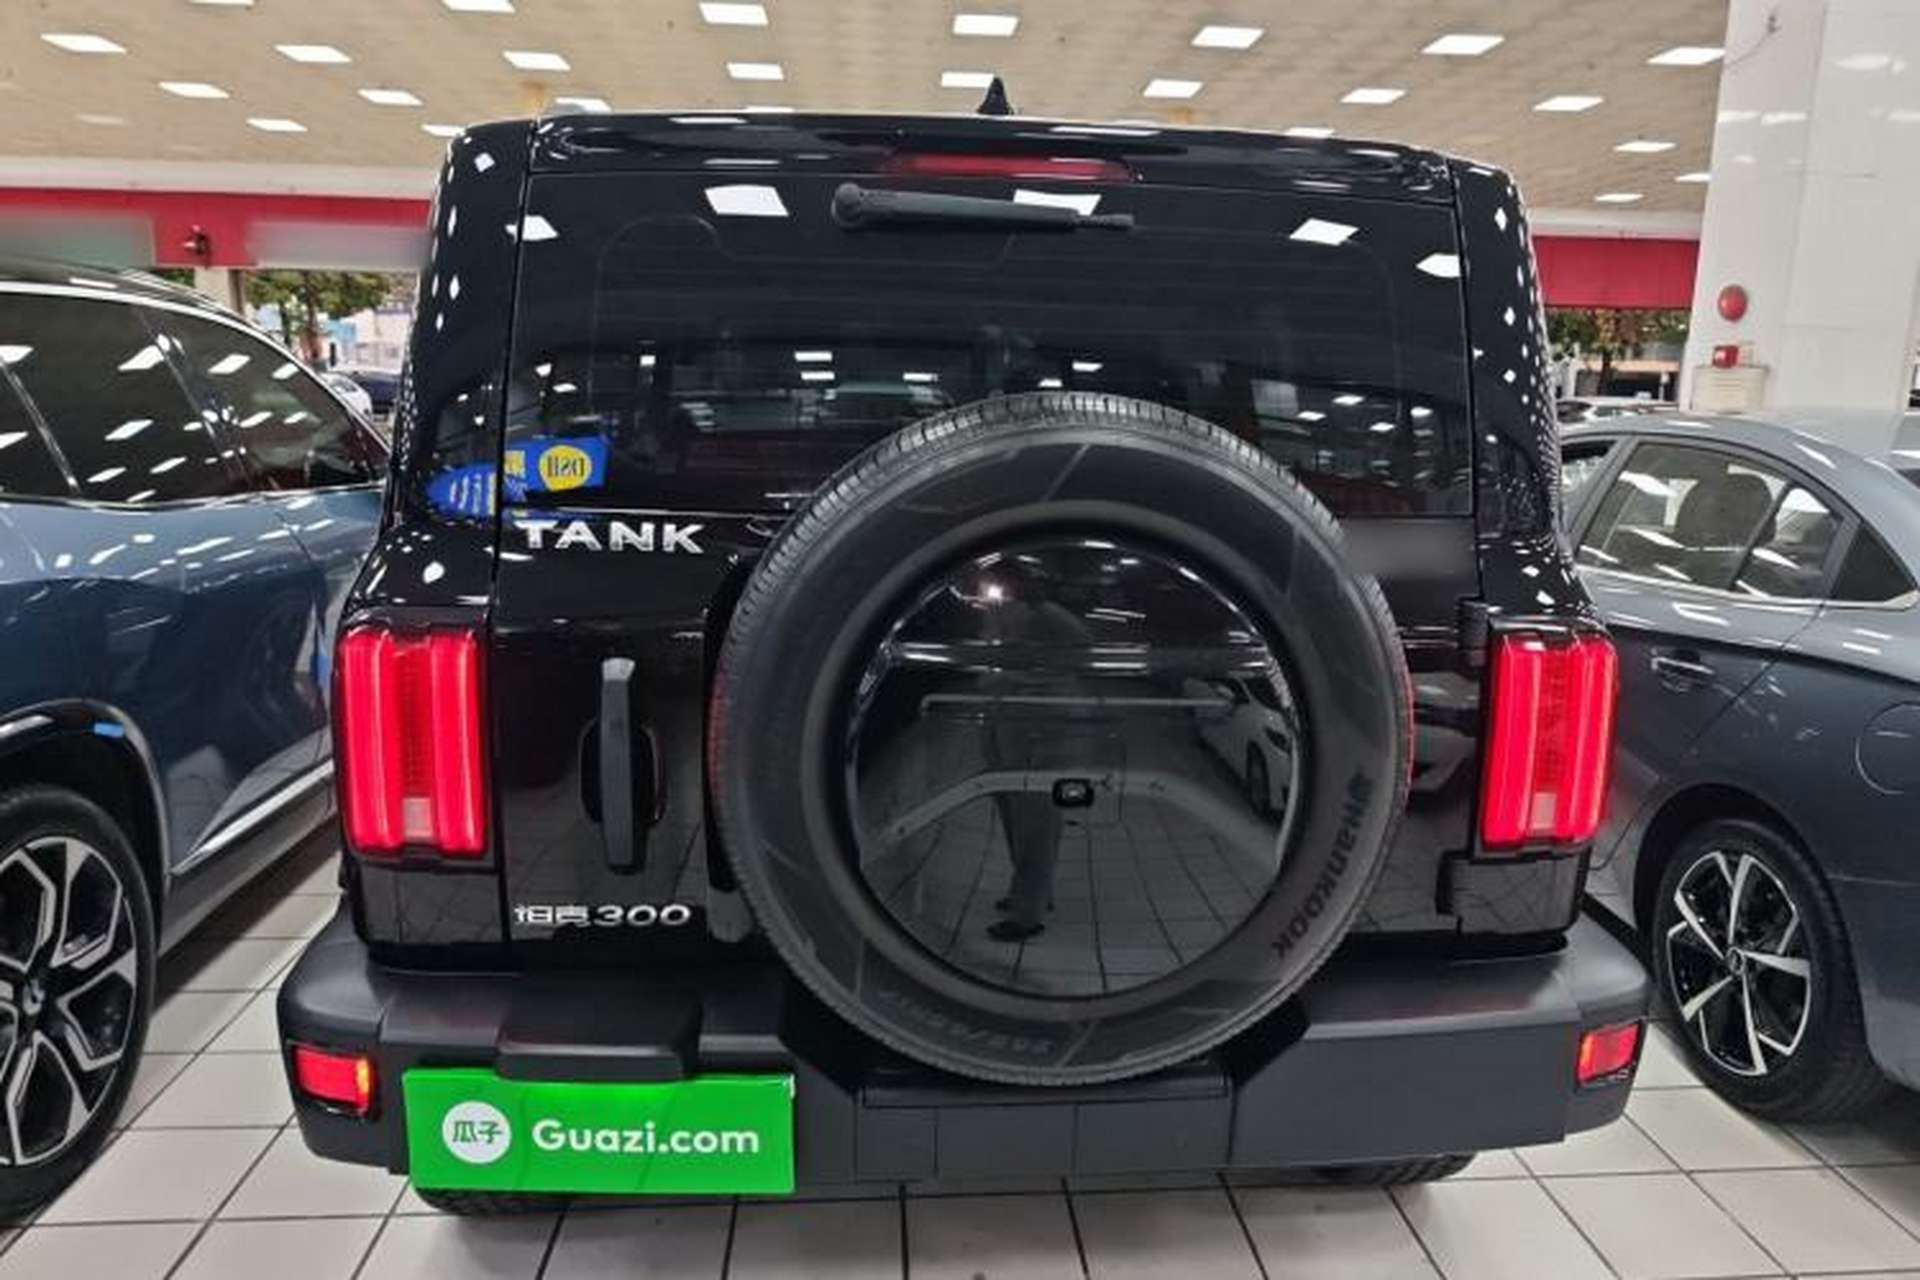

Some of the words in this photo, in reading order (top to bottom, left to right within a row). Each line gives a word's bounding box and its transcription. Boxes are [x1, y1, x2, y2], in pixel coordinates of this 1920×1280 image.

[514, 520, 704, 553] TANK
[451, 1120, 503, 1145] 瓜子
[531, 1118, 760, 1154] Guazi.com
